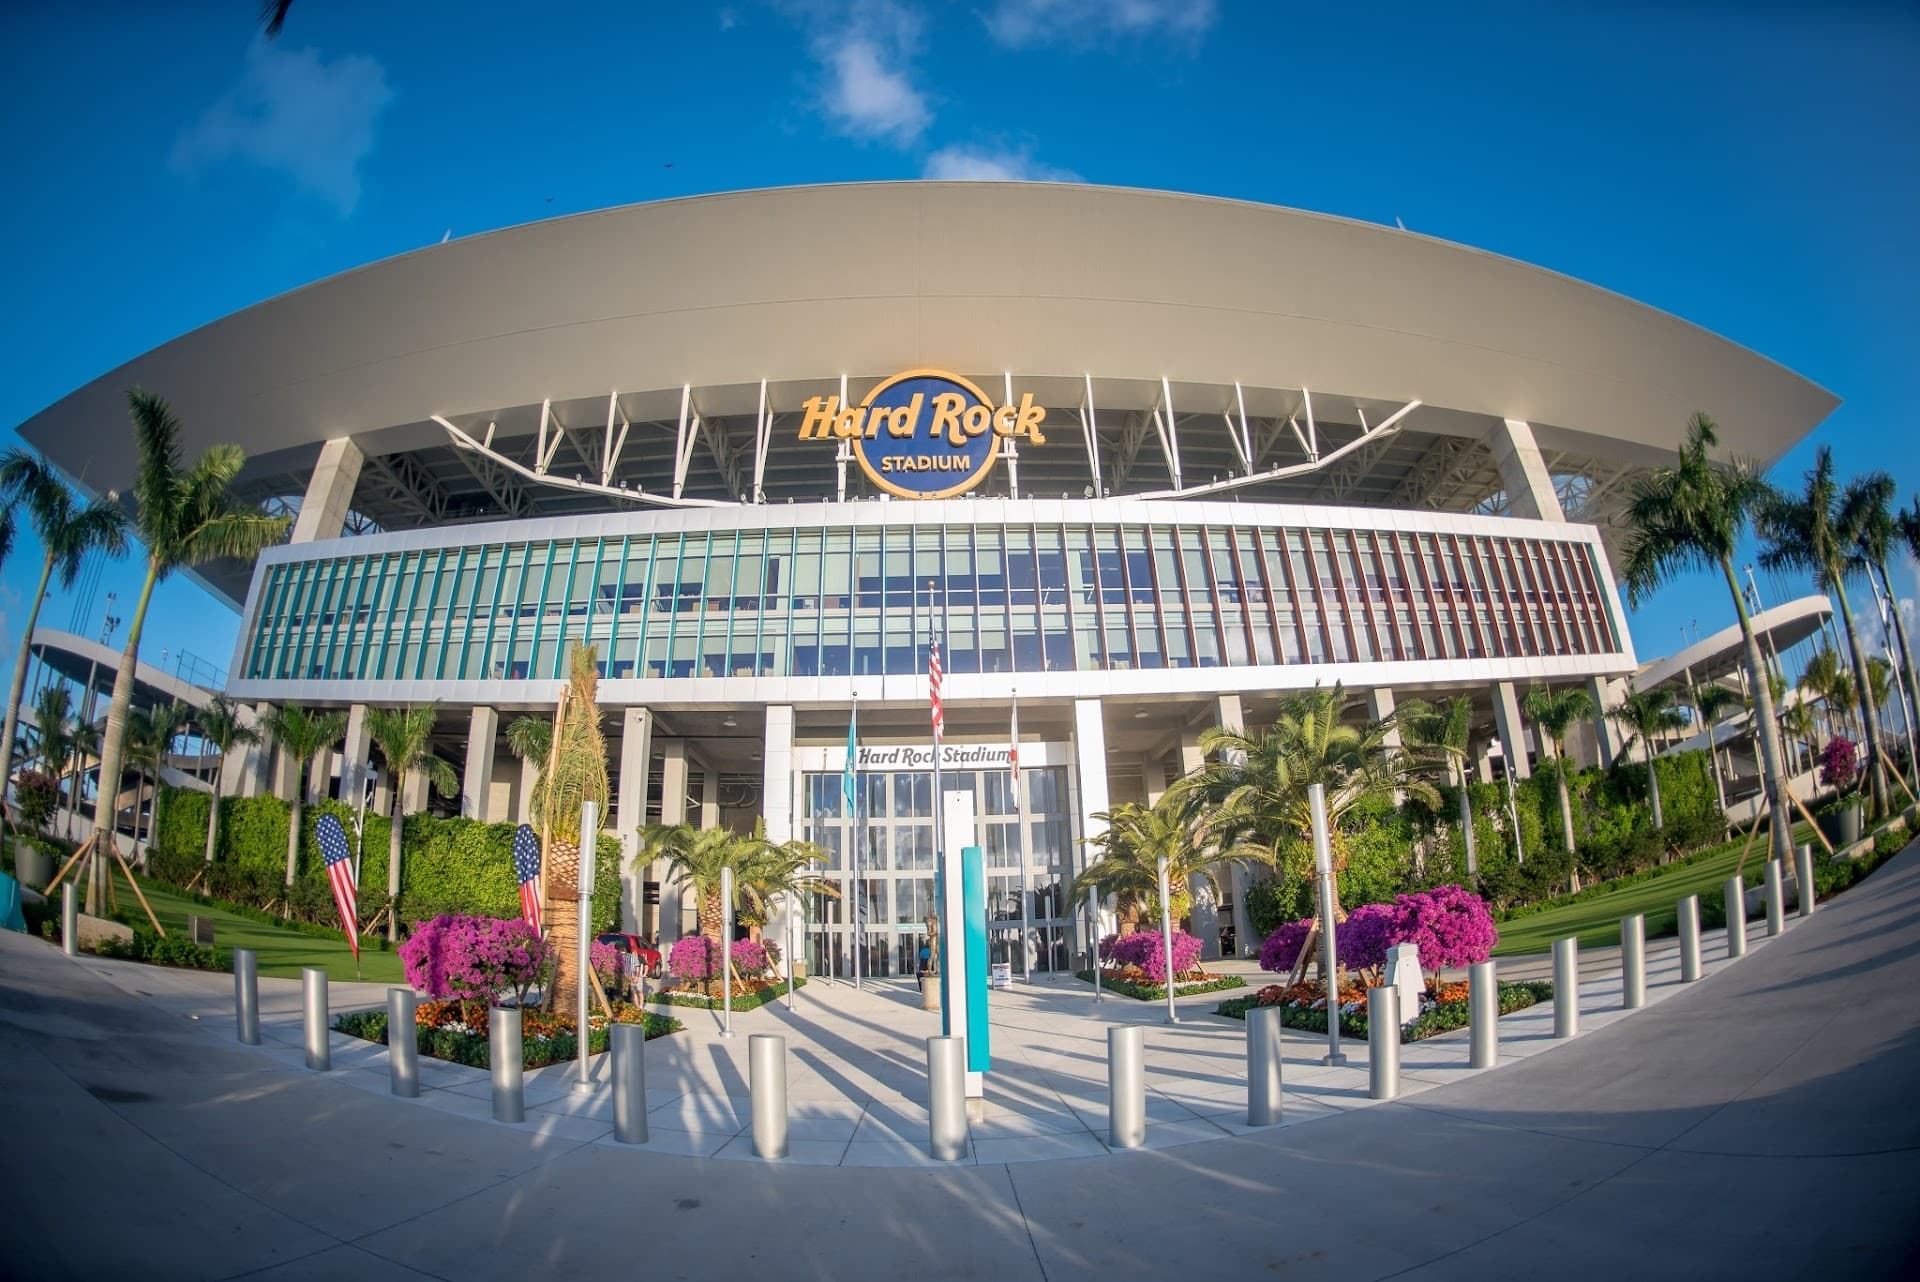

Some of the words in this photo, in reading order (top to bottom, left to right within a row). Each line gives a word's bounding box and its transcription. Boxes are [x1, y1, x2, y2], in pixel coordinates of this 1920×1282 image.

[798, 392, 924, 439] Hard
[930, 392, 1046, 445] Rock
[881, 455, 970, 473] STADIUM
[858, 747, 900, 764] Hard
[942, 746, 1011, 764] Stadium
